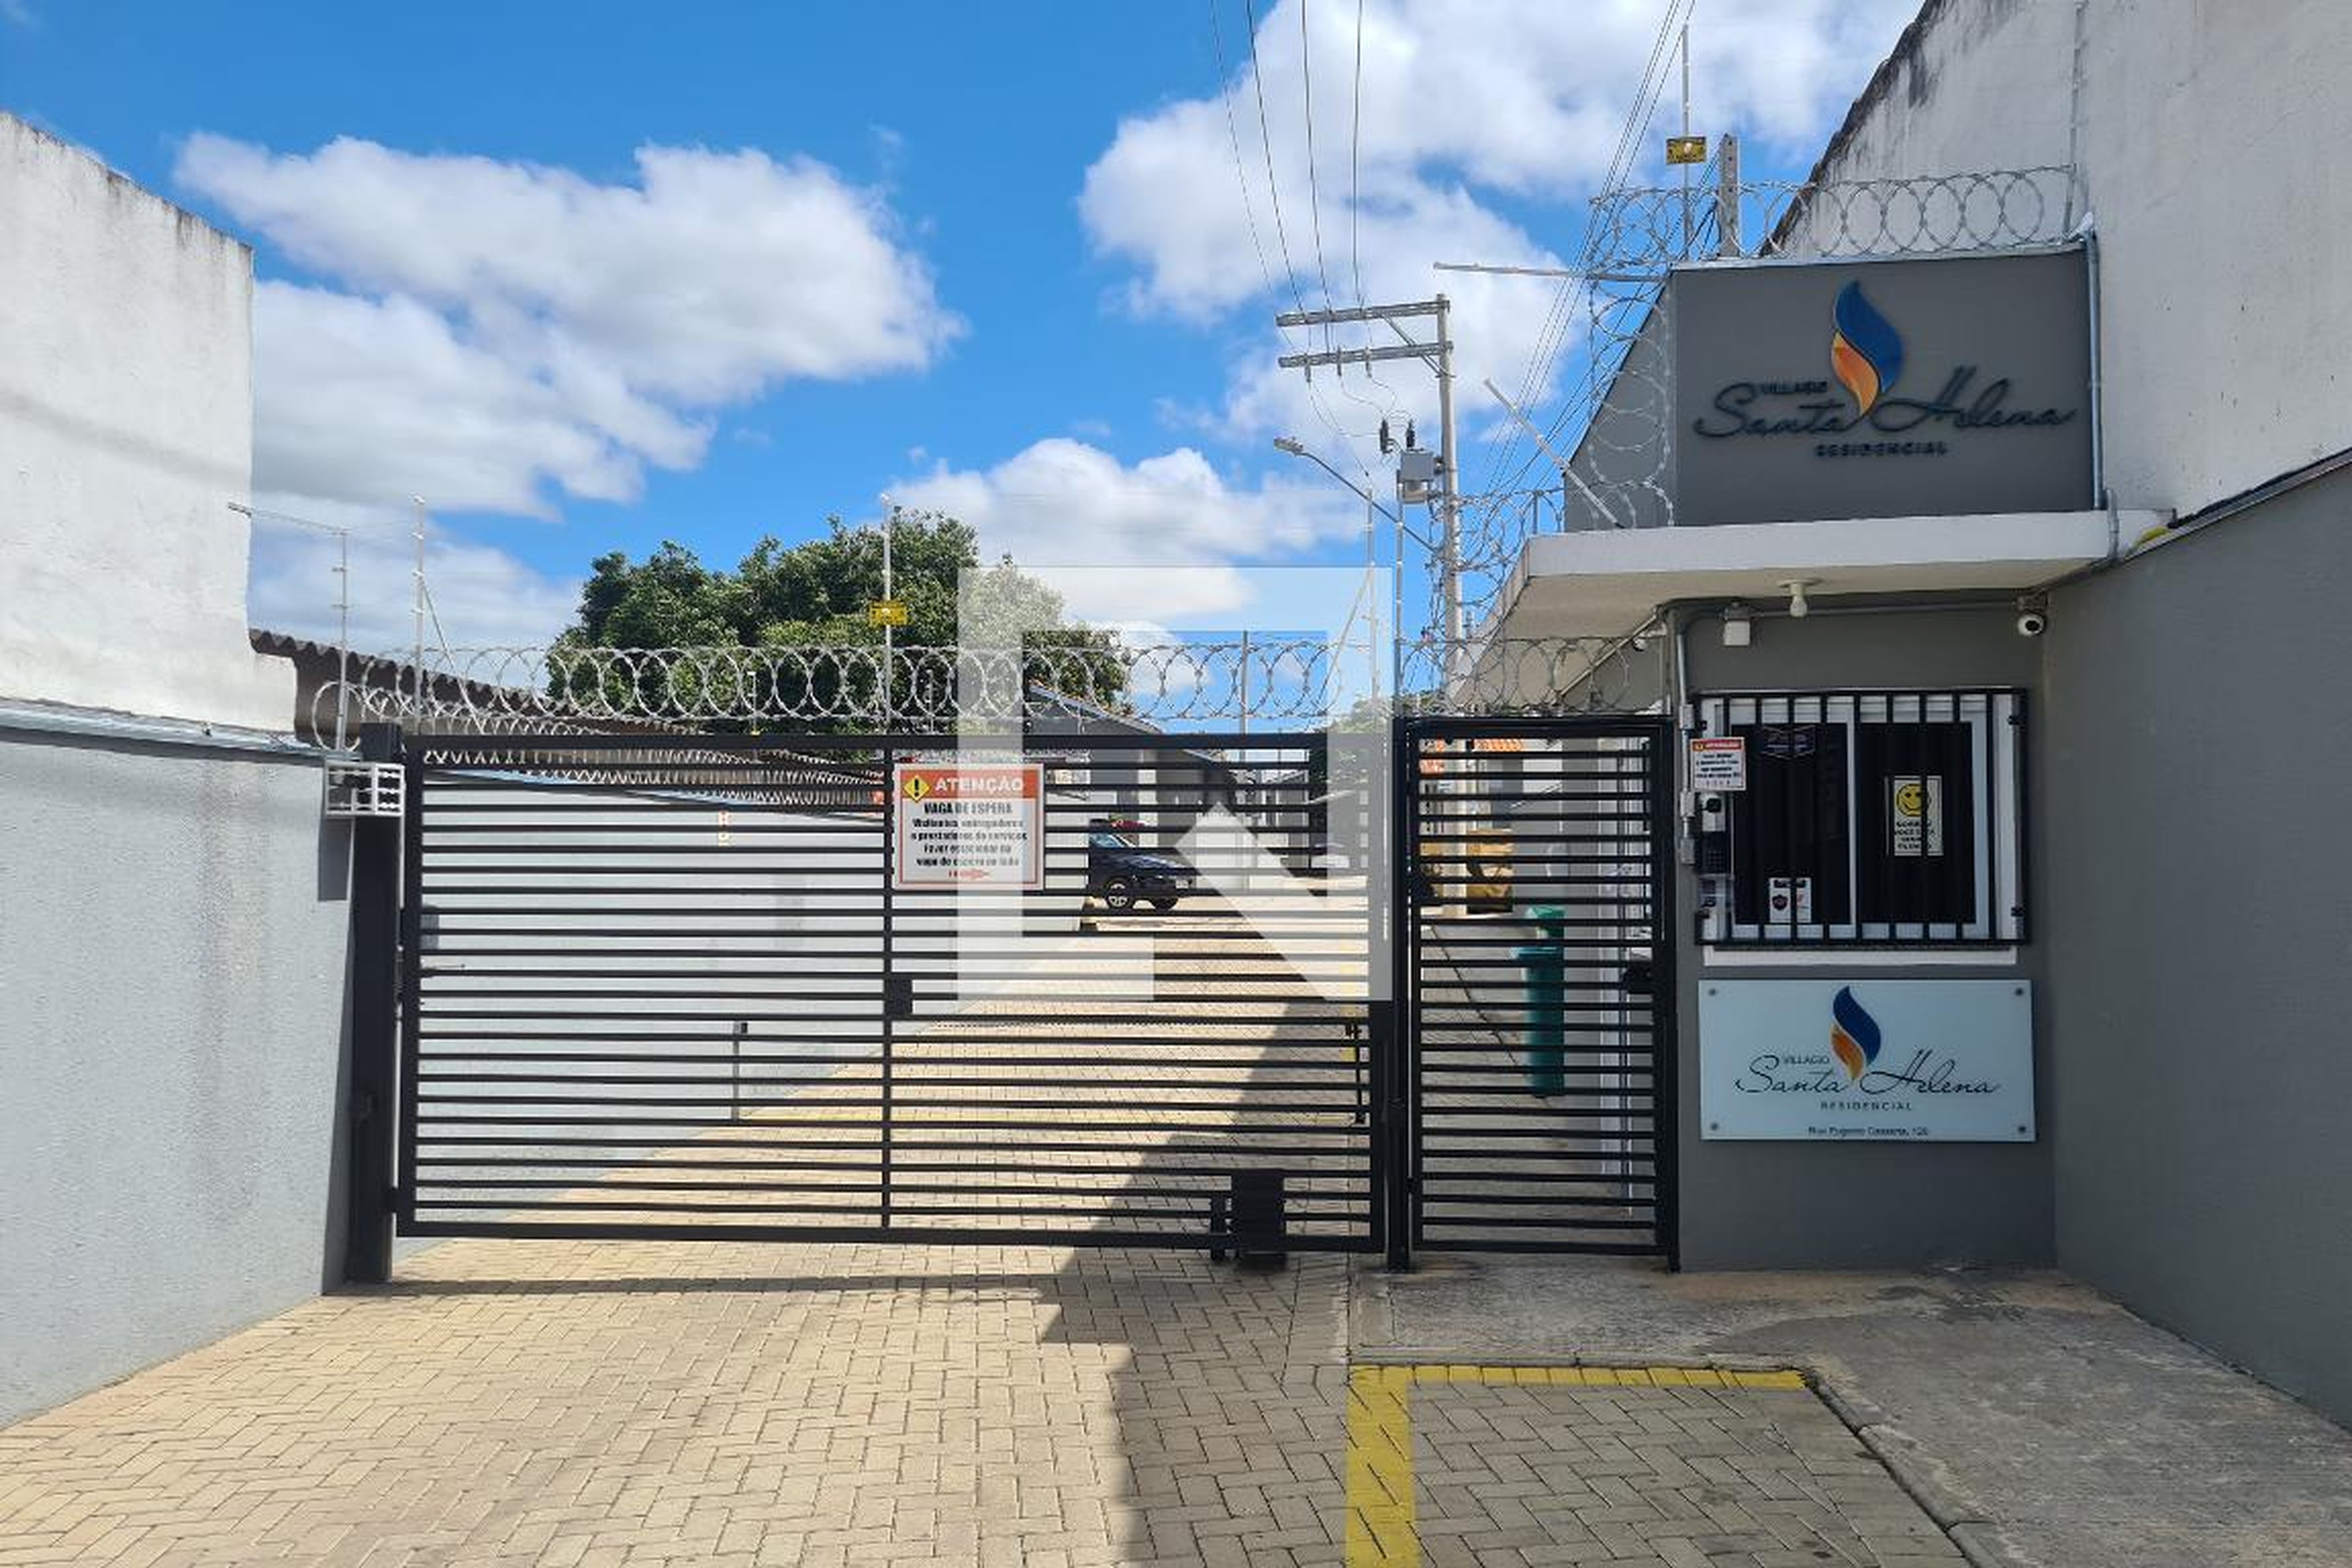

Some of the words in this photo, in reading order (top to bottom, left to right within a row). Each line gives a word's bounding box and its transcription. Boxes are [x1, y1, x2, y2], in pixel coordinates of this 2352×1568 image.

[1692, 382, 1868, 437] Santa
[1870, 366, 2077, 432] Helena
[1815, 442, 1949, 458] RESIDENCIAL
[935, 775, 1023, 794] ATENÇÃO
[924, 802, 954, 814] VAGA
[955, 802, 970, 814] DE
[971, 802, 1013, 814] ESPERA
[1782, 1054, 1831, 1065] VILLAGIO
[1735, 1055, 1849, 1093] Santa
[1860, 1049, 2000, 1095] Helena
[1820, 1101, 1912, 1112] RESIDENCIAL
